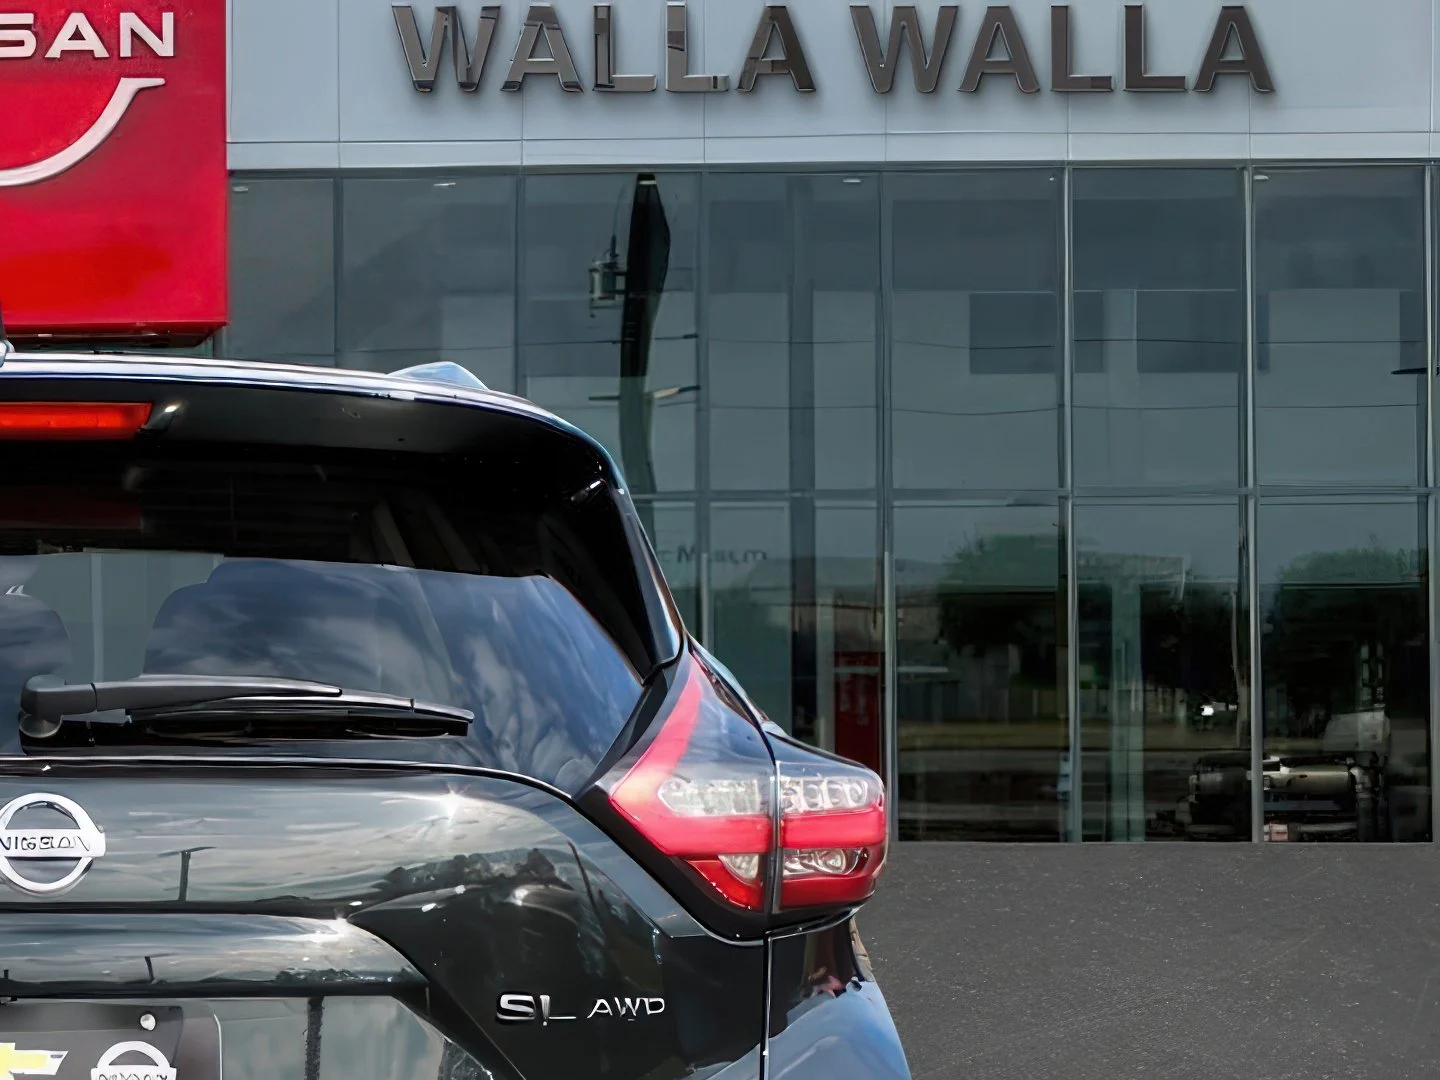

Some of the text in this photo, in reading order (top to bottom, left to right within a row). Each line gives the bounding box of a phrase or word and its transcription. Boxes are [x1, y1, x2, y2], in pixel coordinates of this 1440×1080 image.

[391, 2, 1275, 94] WALLA WALLA
[497, 994, 665, 1022] SL AWD
